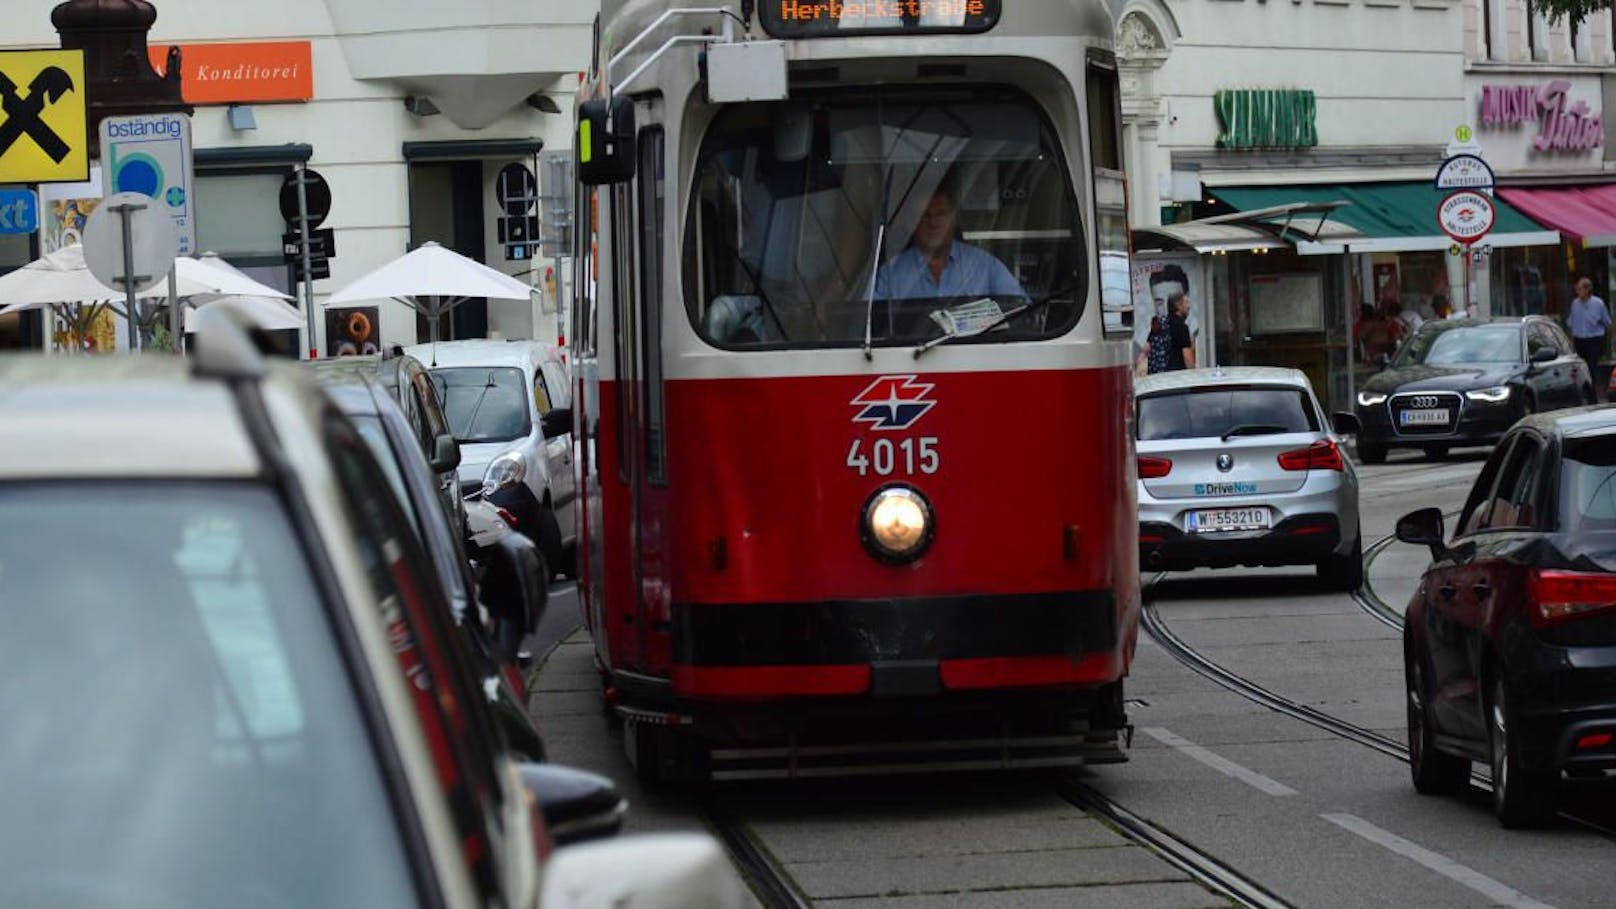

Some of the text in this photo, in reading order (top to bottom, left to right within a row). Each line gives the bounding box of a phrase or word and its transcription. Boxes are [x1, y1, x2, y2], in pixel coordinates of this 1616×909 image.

[197, 63, 298, 81] Konditorei
[1482, 85, 1537, 123] MUSIK
[107, 117, 181, 137] bständig
[1449, 159, 1482, 171] AUTOBUS
[846, 436, 939, 476] 4015
[1205, 482, 1257, 495] DriveNow
